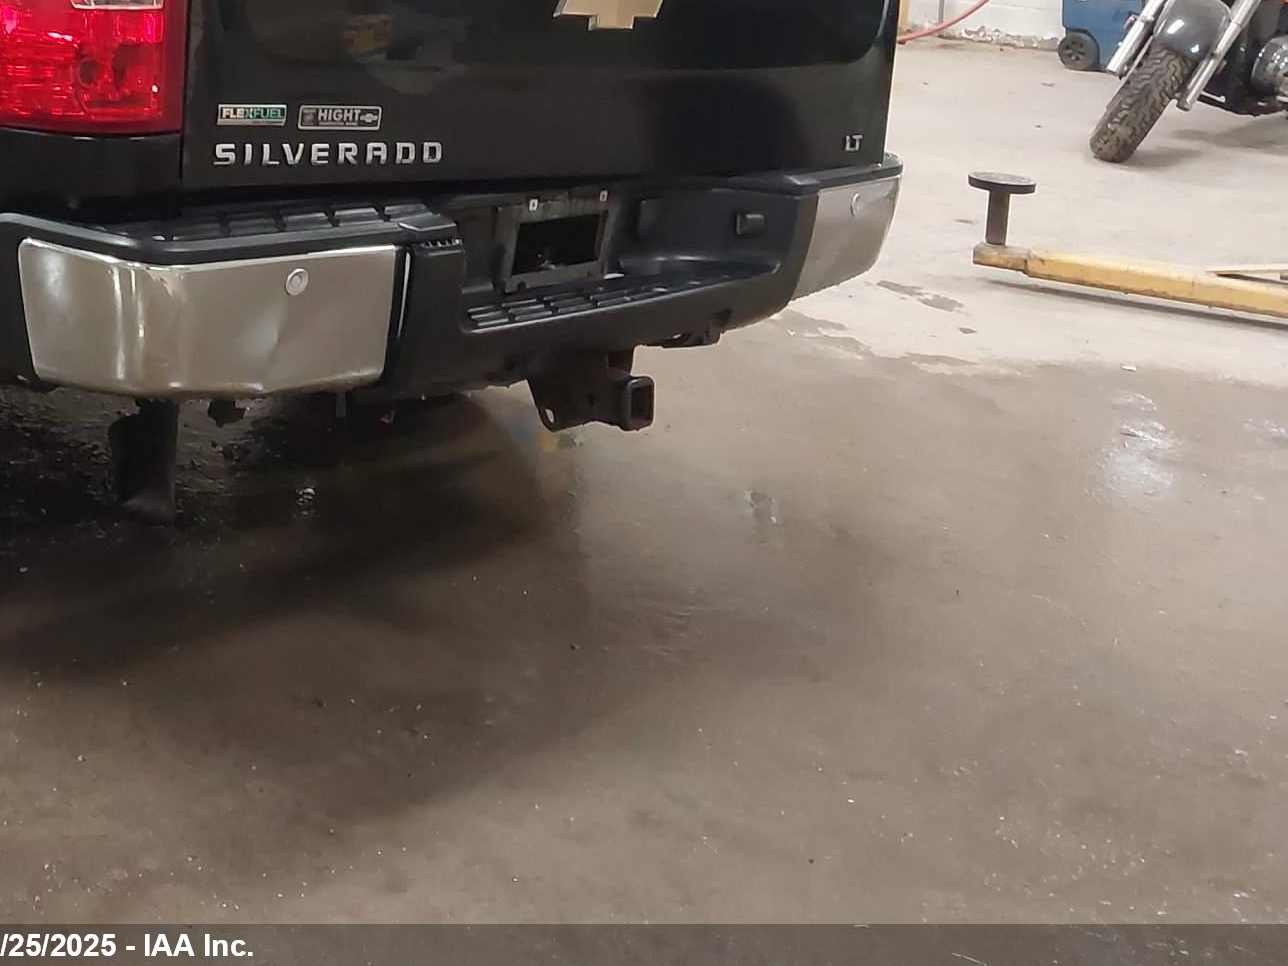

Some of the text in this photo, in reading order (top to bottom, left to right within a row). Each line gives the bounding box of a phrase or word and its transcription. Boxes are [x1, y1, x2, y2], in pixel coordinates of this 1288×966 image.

[318, 108, 362, 122] HIGHT
[845, 134, 864, 152] LT
[213, 141, 443, 166] SILVERADO
